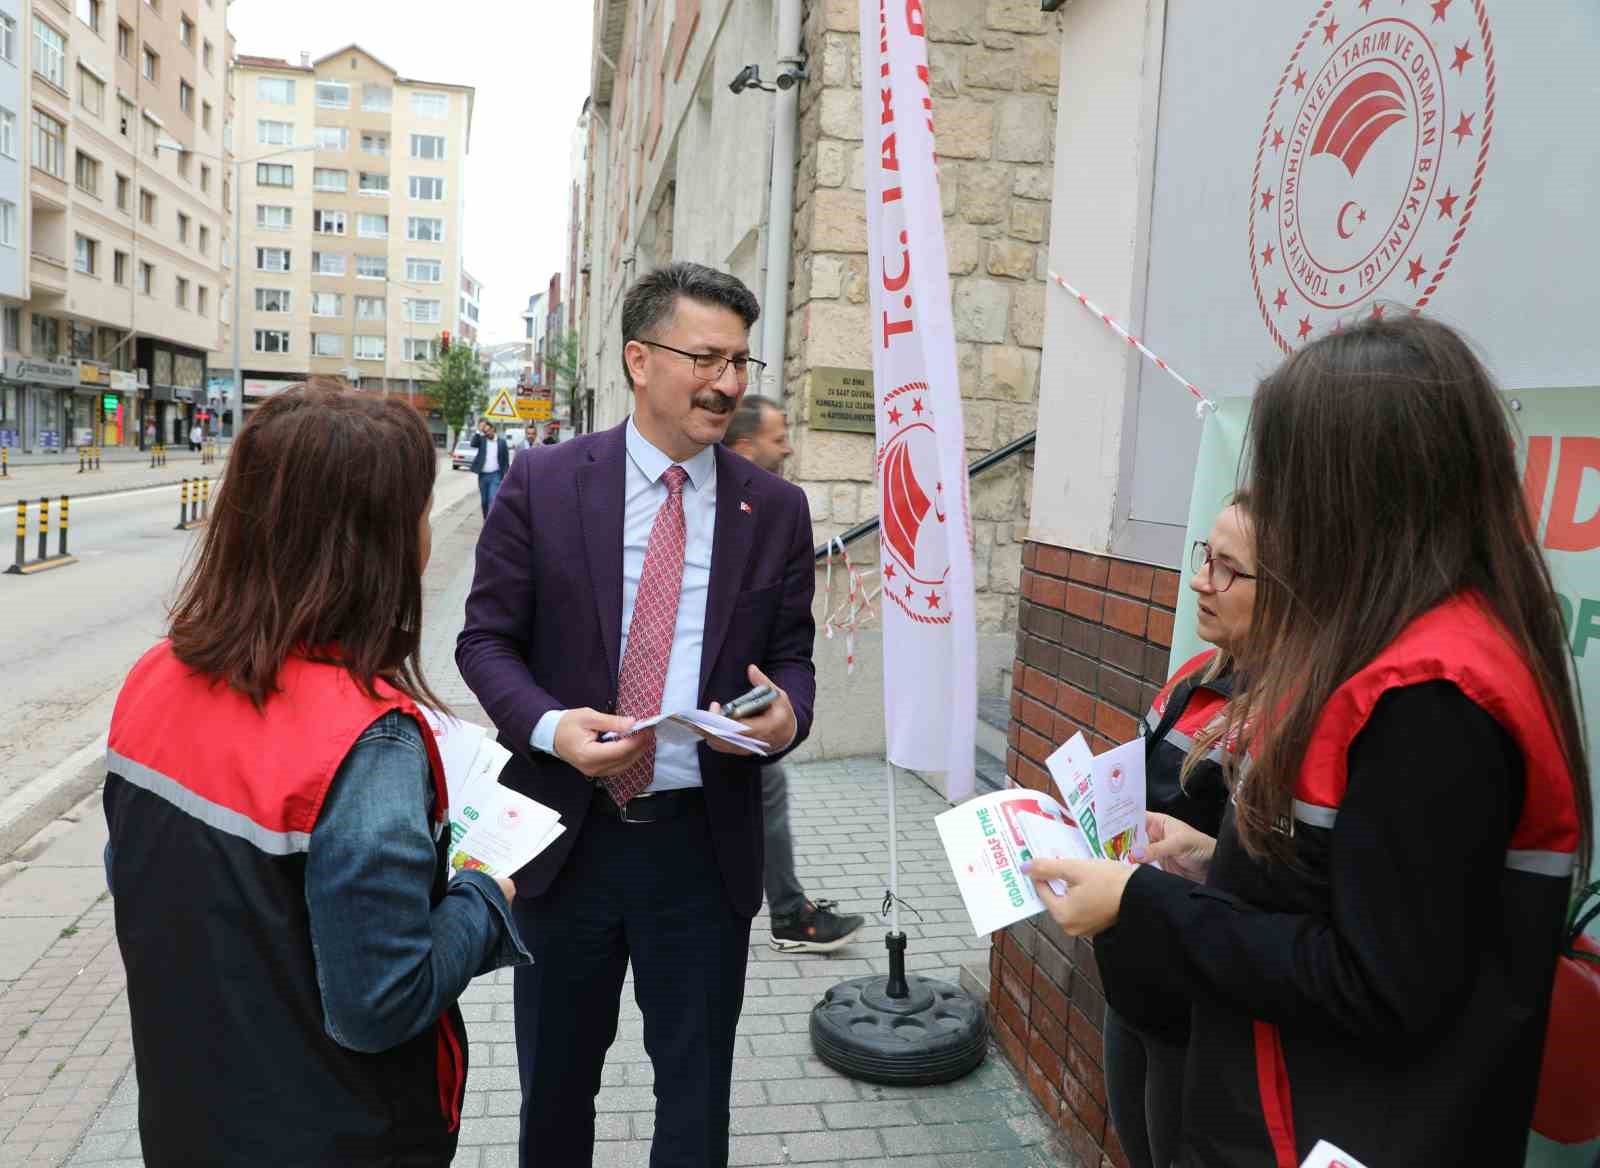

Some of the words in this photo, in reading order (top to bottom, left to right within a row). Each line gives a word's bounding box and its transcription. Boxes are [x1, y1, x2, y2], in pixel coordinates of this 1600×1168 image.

[1342, 31, 1393, 66] TARIM
[1394, 32, 1414, 62] VE
[1411, 54, 1437, 147] ORMAN
[1358, 157, 1432, 289] BAKANLIĞI
[882, 230, 914, 349] T.C.
